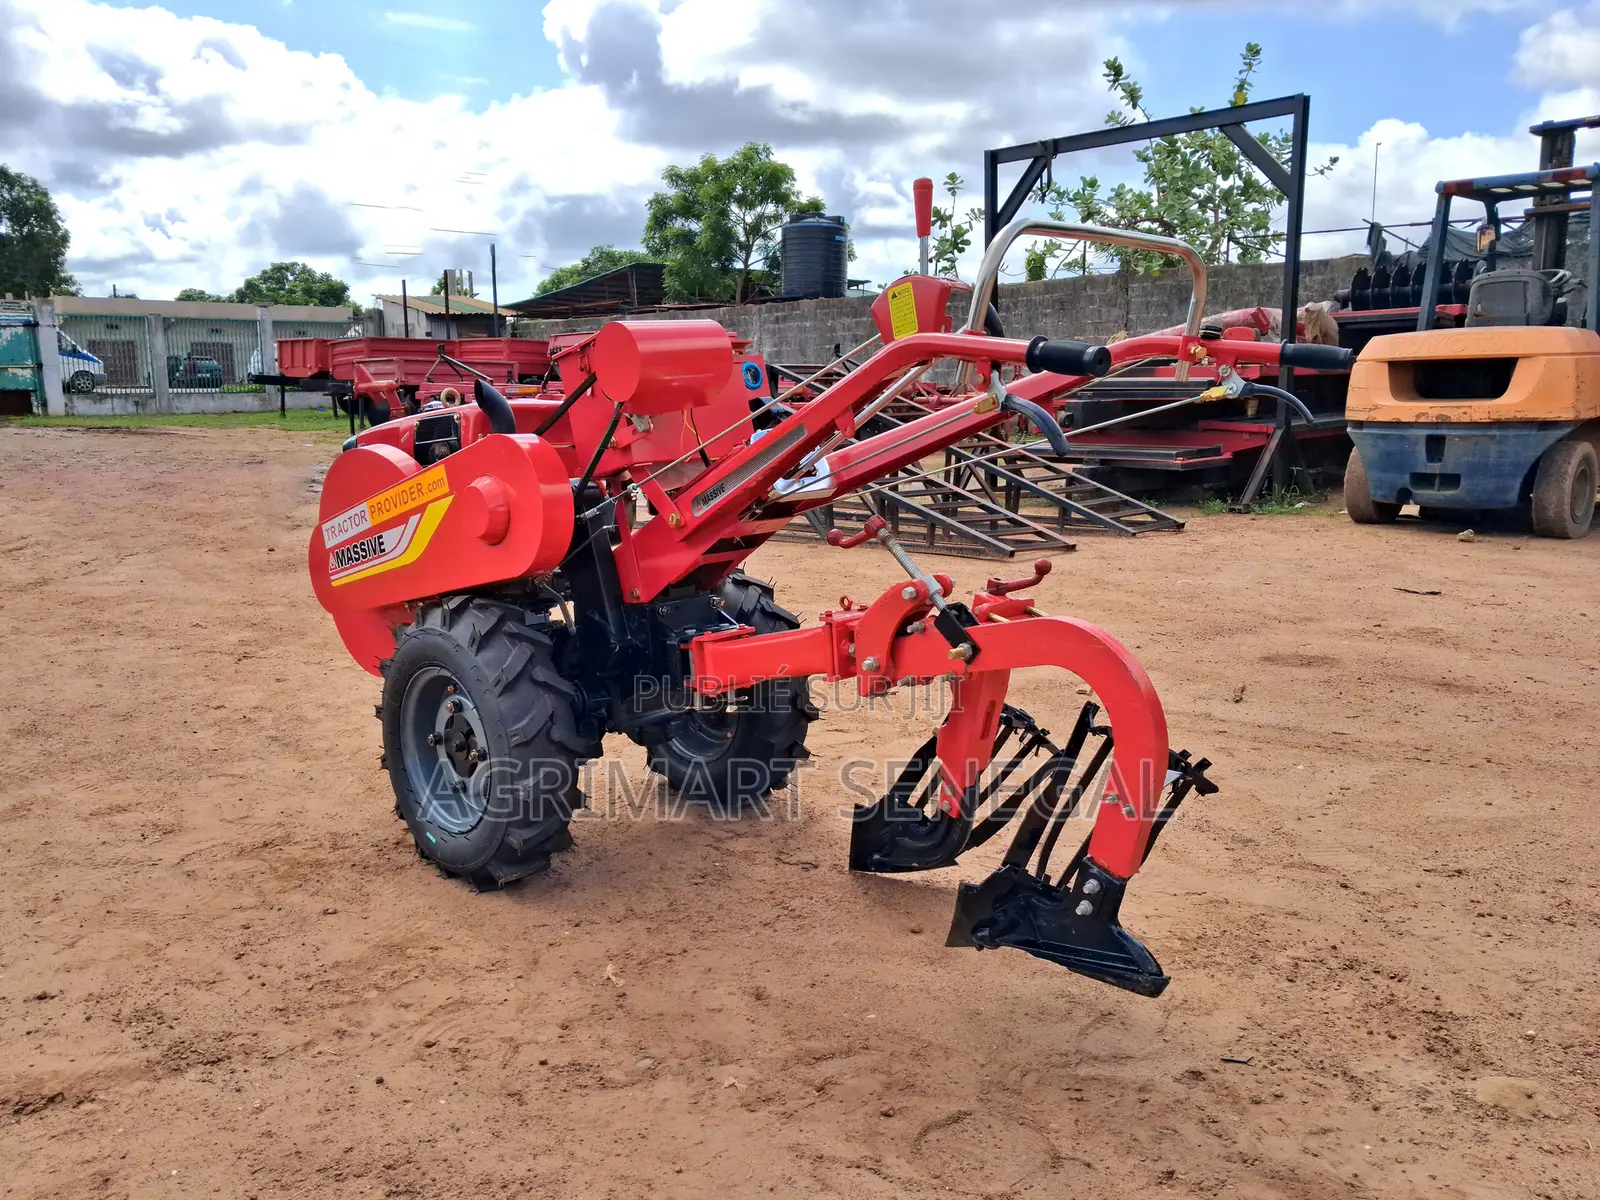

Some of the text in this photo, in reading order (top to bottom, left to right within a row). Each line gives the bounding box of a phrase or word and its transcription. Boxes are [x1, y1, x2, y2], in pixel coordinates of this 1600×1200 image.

[701, 483, 726, 507] MASSIVE
[325, 509, 368, 542] TRACTOR
[335, 534, 386, 568] MASSIVE
